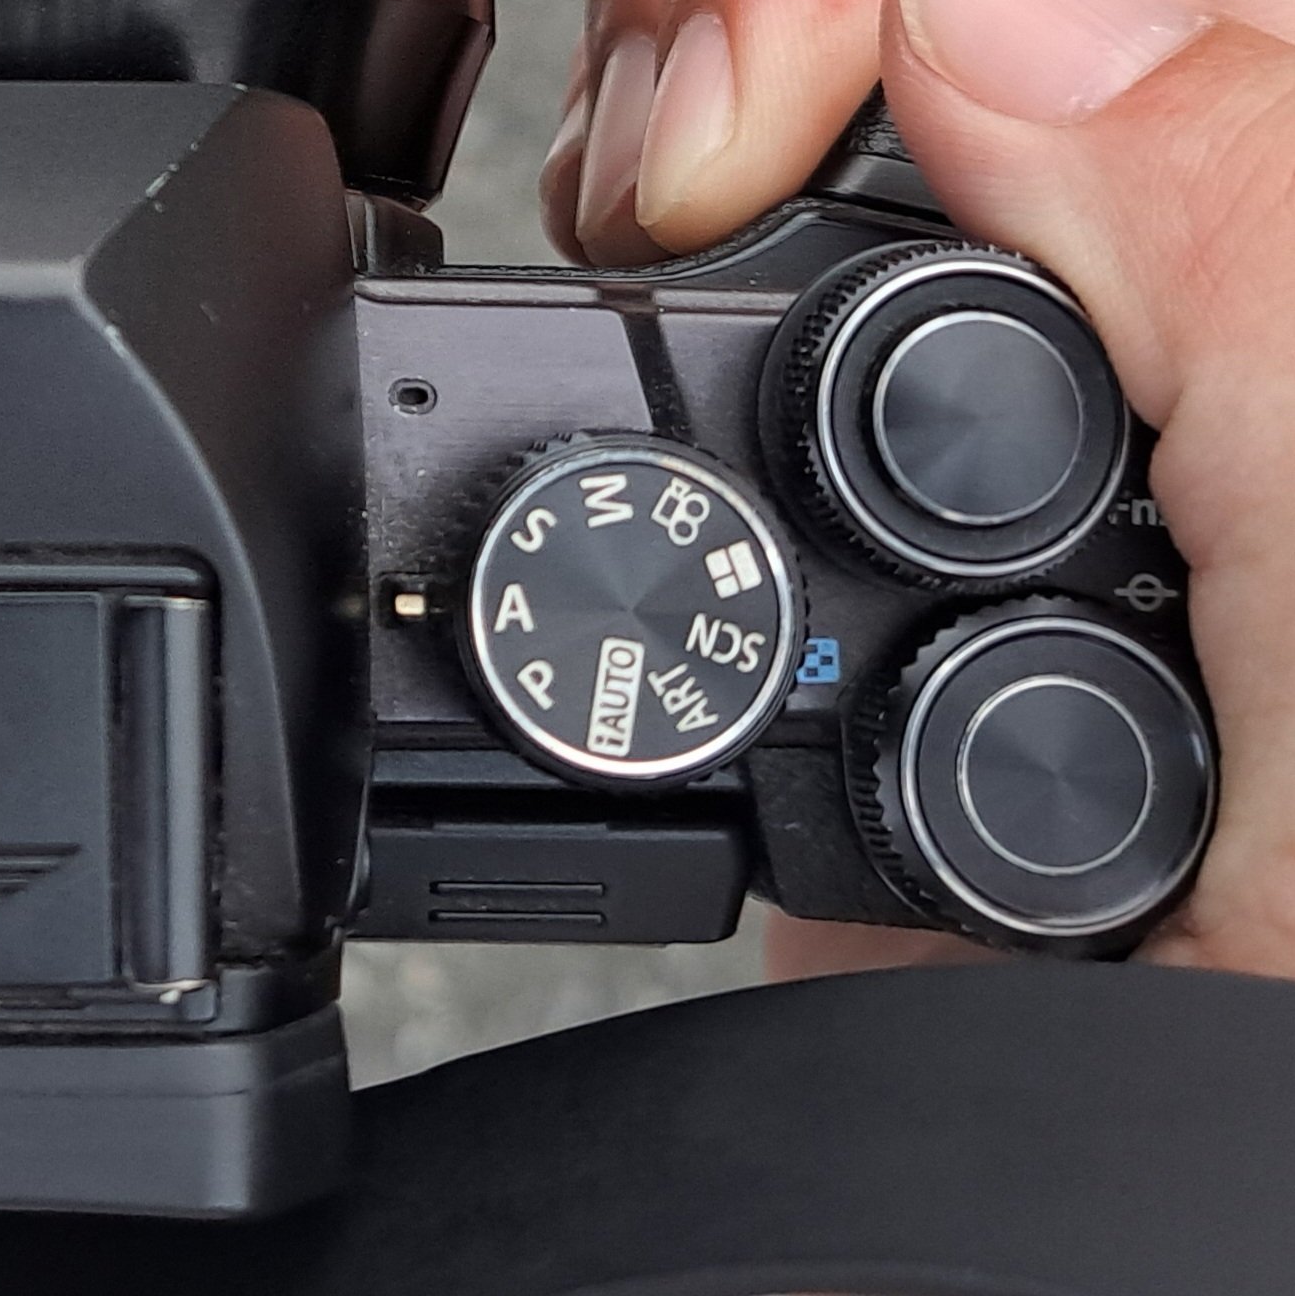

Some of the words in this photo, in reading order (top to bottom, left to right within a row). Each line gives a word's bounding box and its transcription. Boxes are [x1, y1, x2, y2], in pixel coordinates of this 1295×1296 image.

[578, 473, 635, 529] M
[510, 508, 558, 553] S
[493, 583, 535, 633] A
[685, 612, 766, 674] SCN
[516, 660, 555, 711] P
[593, 646, 636, 749] iAUTO
[647, 663, 719, 733] ART
